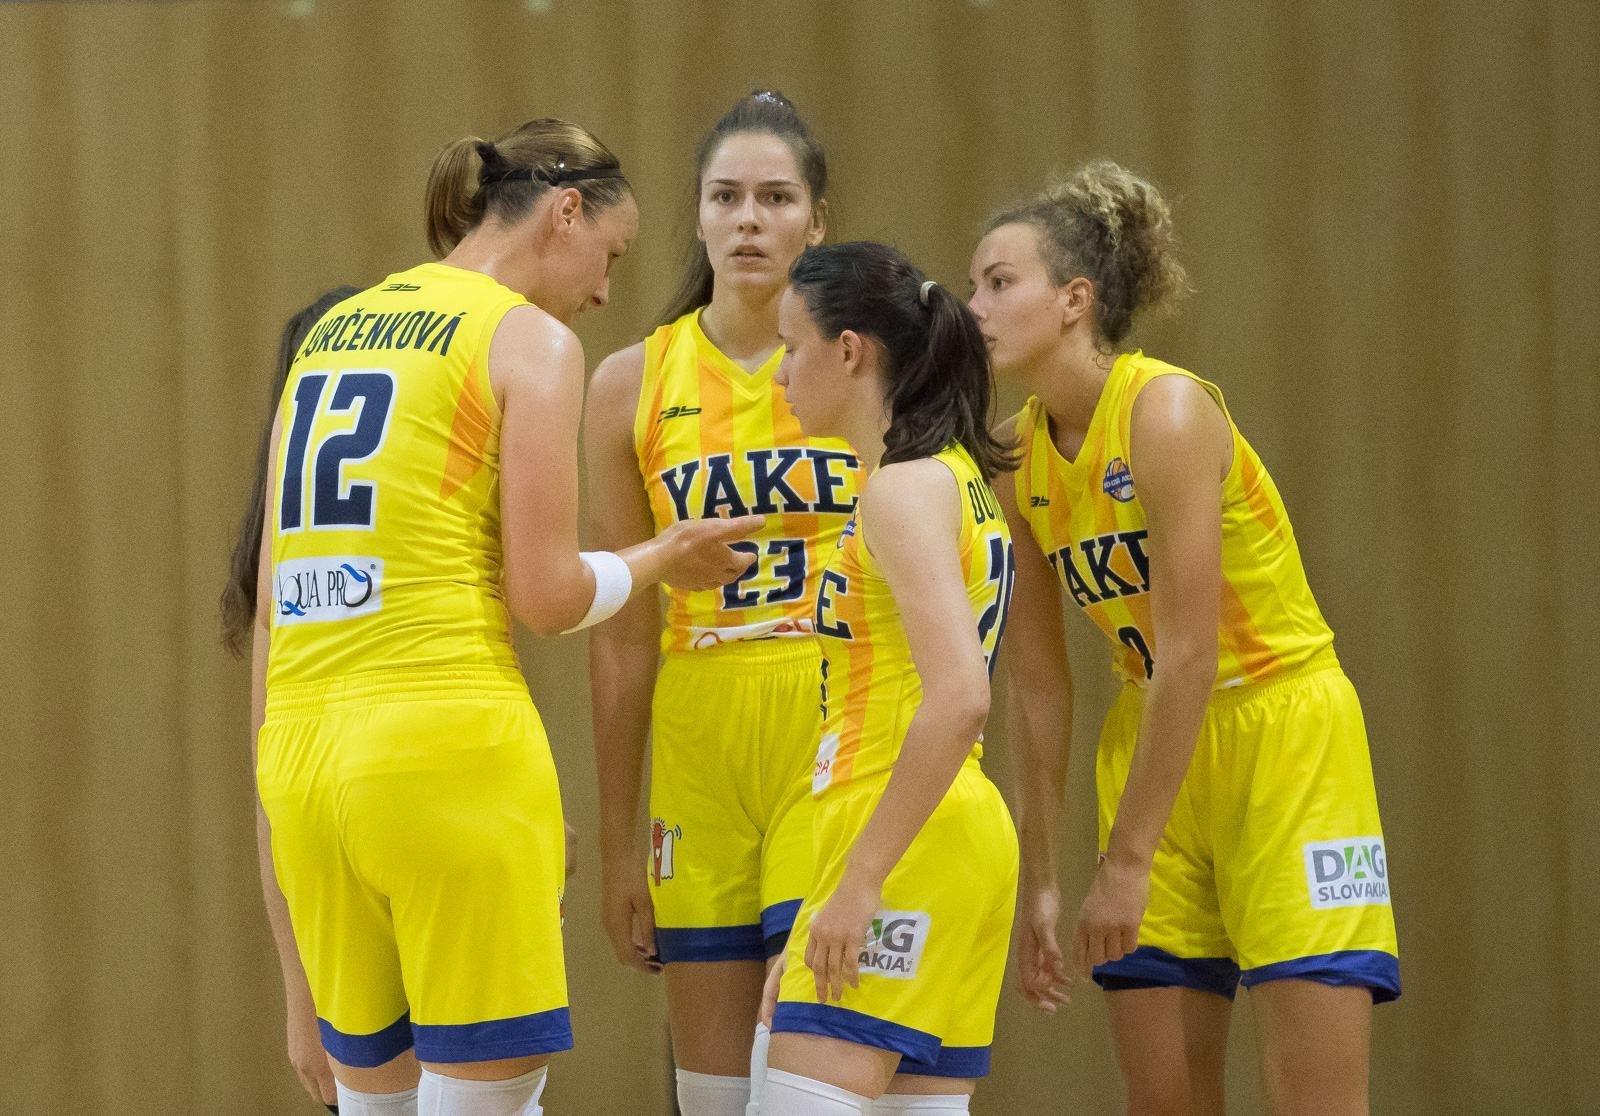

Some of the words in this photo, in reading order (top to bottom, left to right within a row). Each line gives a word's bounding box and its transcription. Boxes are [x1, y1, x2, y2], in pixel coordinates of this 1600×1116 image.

[295, 308, 468, 364] URČENKOVÁ
[279, 372, 392, 532] 12
[660, 448, 860, 522] YAKE
[722, 538, 807, 610] 23
[1318, 881, 1387, 902] SLOVAKIA
[858, 951, 905, 973] AKIA
